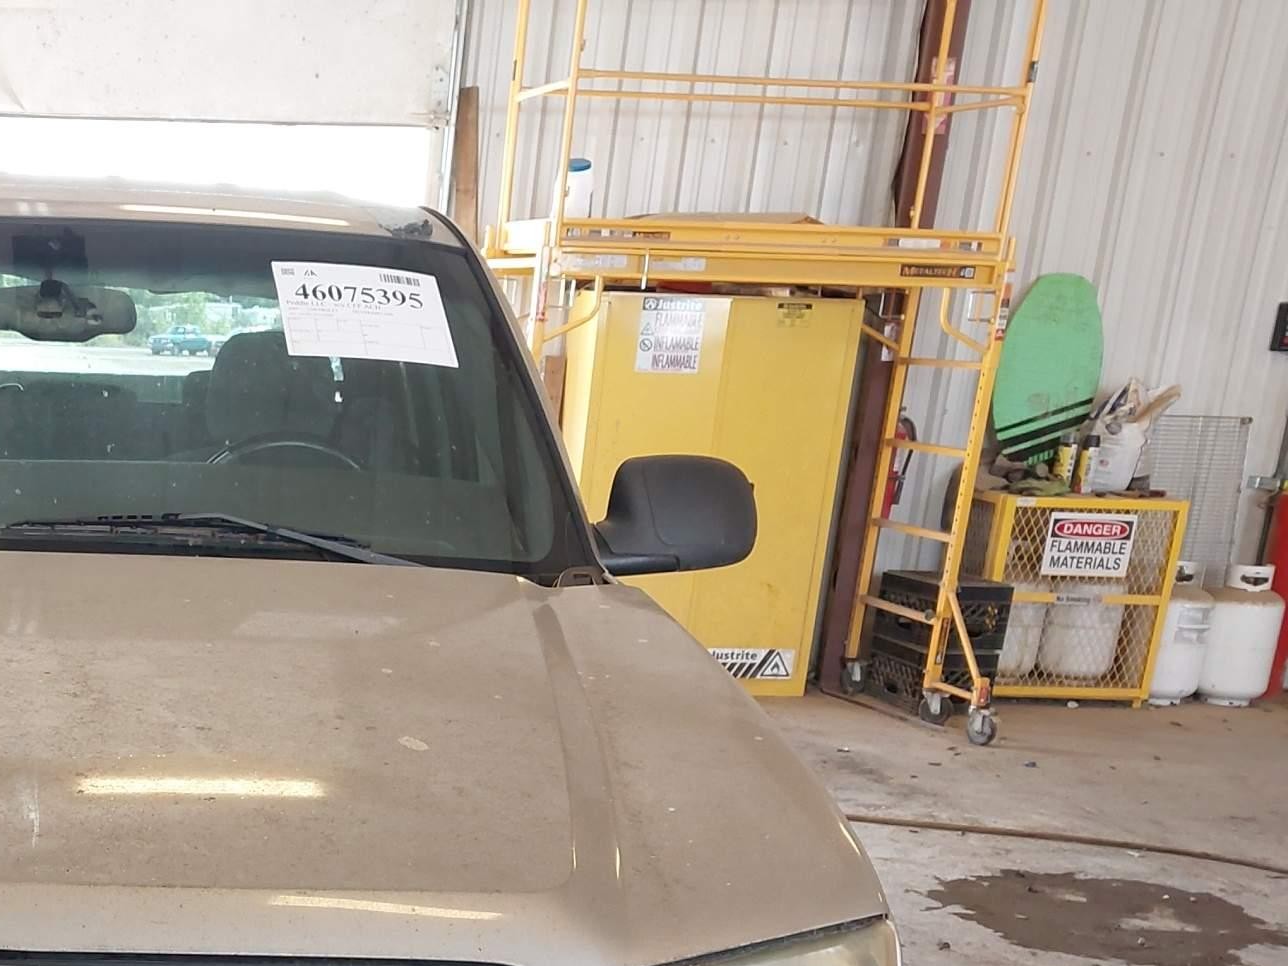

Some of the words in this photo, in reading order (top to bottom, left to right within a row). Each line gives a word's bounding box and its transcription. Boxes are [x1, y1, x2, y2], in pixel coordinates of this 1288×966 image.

[295, 282, 424, 309] 46075395
[657, 297, 703, 310] Justrite
[654, 311, 703, 328] FLAMMABLE
[1063, 523, 1121, 536] DANGER
[1049, 539, 1127, 555] FLAMMABLE
[1048, 556, 1121, 571] MATERIALS
